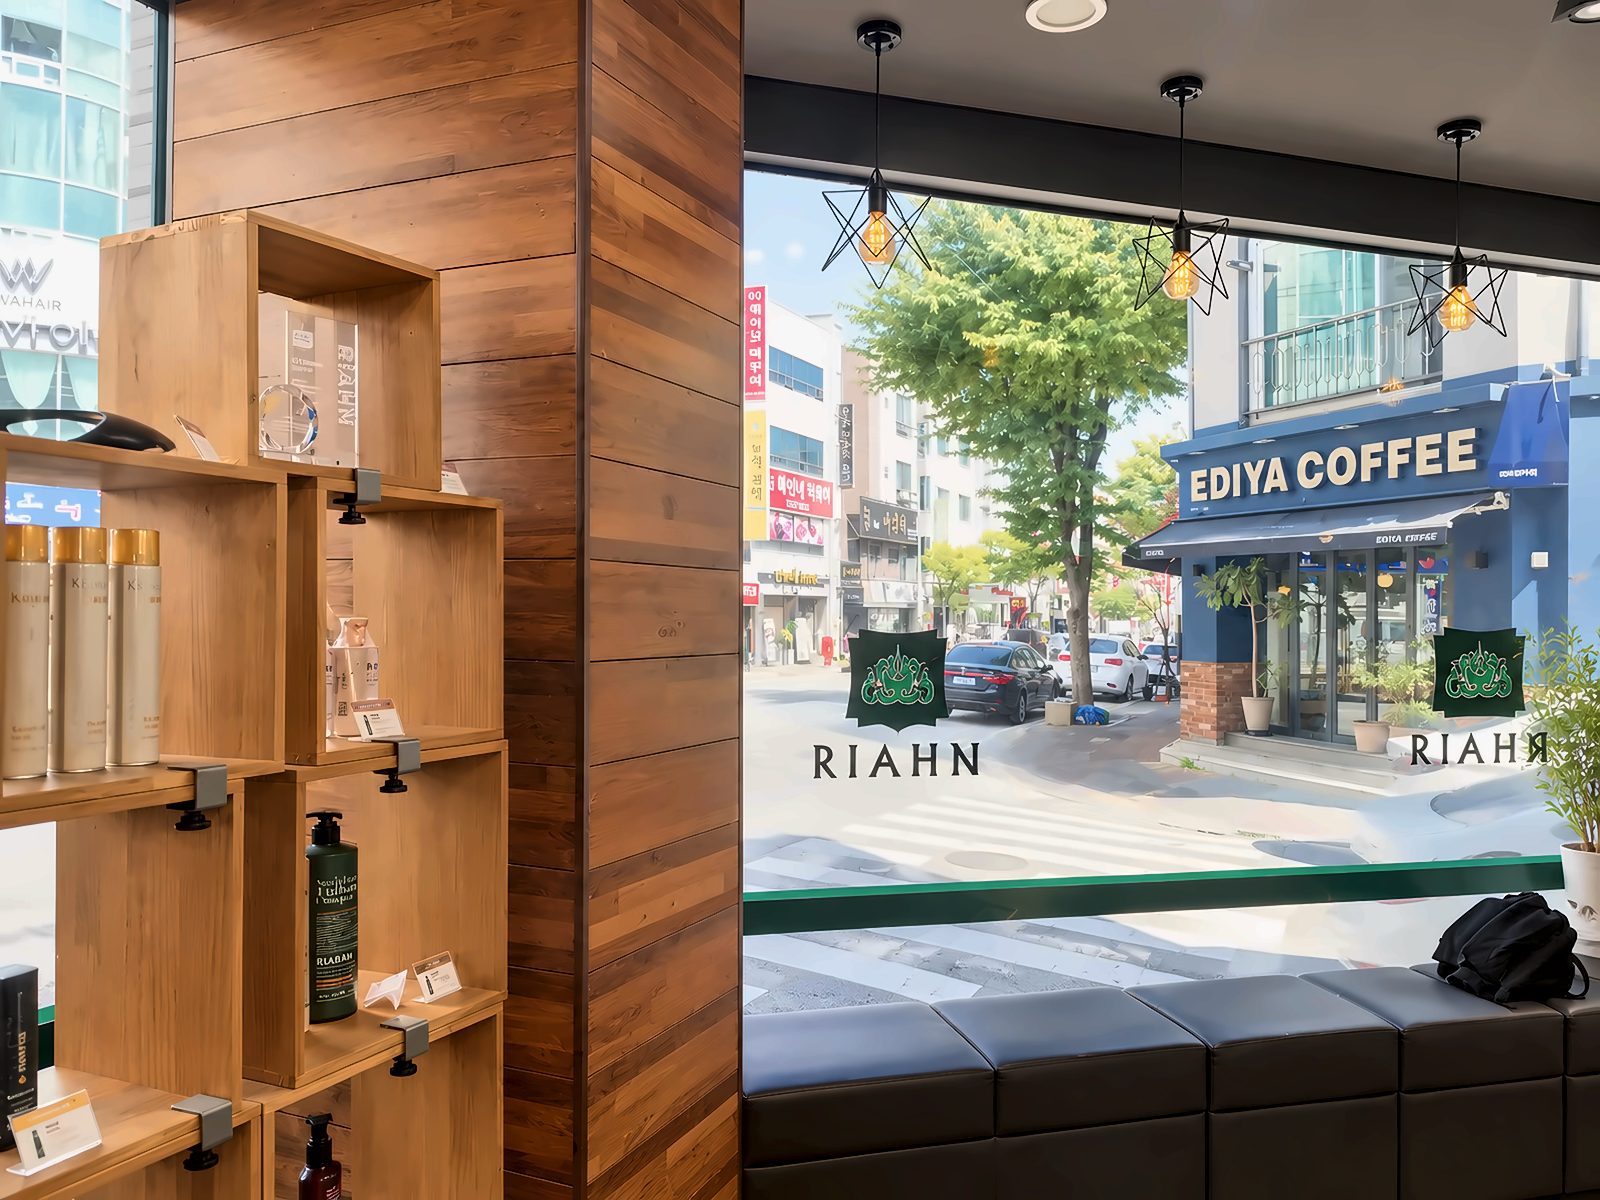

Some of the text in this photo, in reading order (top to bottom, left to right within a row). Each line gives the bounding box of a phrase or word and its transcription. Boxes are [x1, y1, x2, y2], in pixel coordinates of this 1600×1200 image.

[1190, 427, 1478, 502] EDIYA COFFEE
[813, 742, 980, 779] RIAHN
